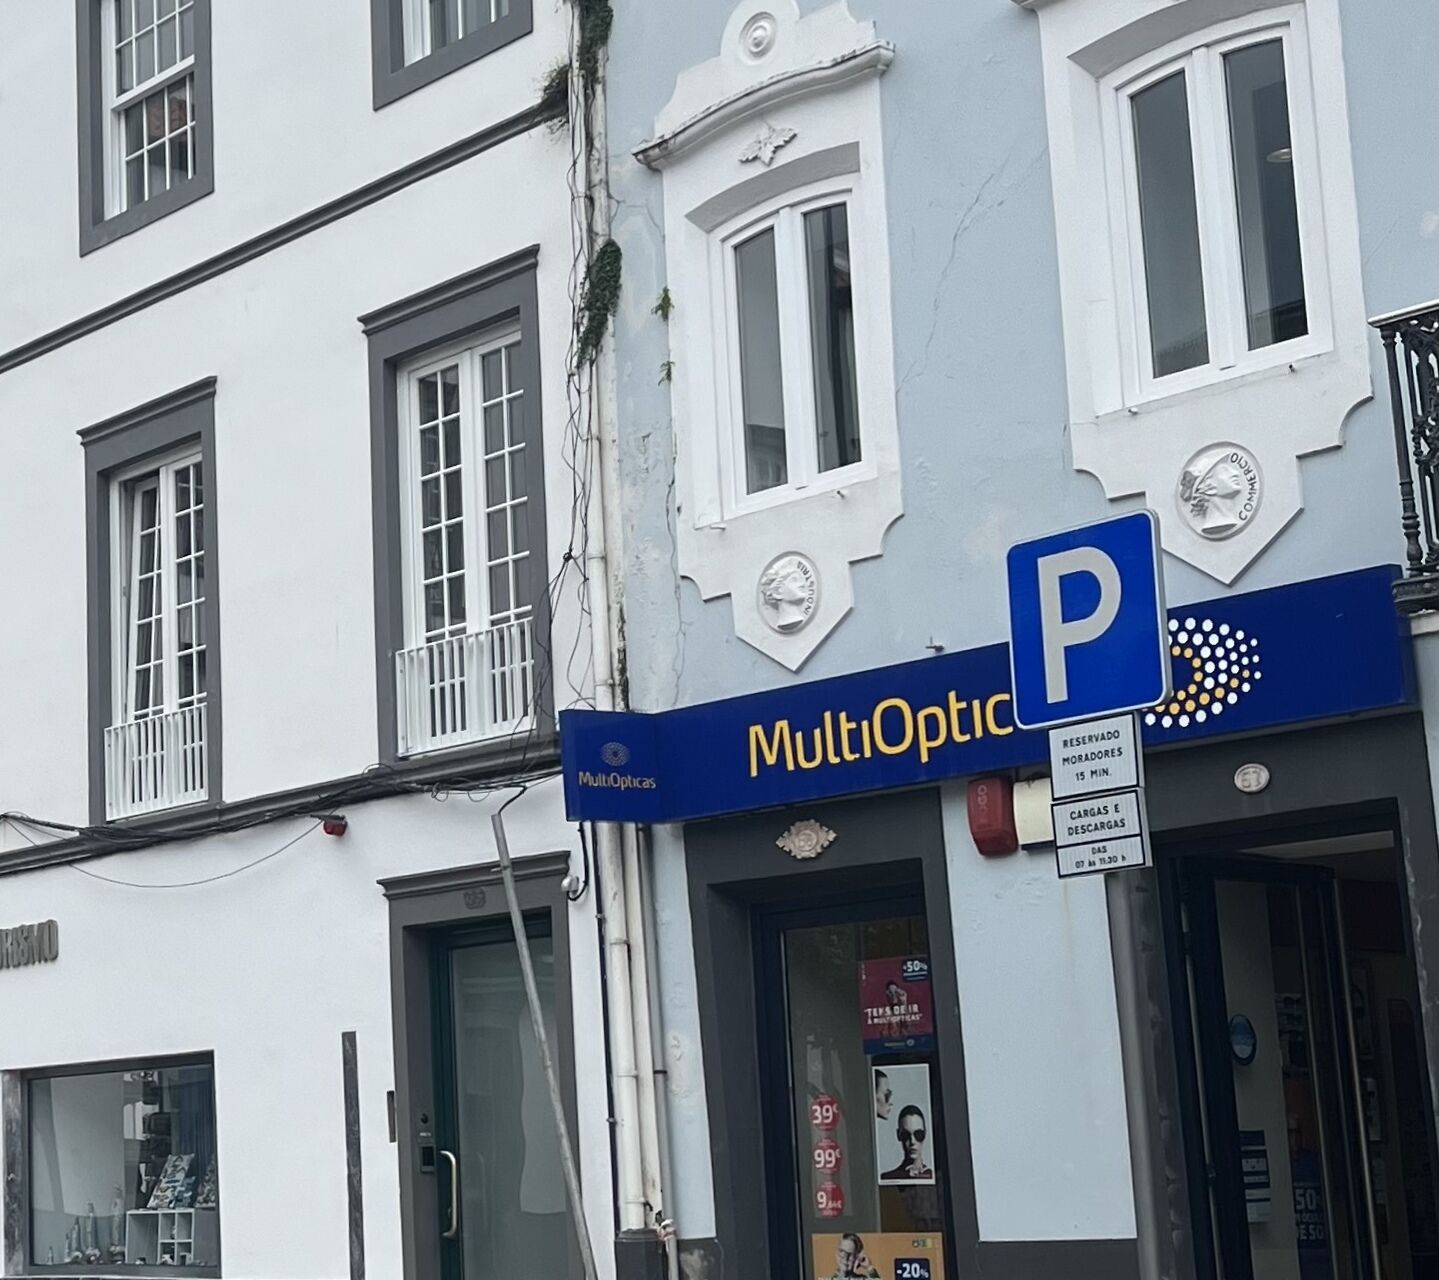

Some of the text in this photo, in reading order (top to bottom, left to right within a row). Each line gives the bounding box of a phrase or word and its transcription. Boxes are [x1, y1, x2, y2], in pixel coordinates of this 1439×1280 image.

[1230, 452, 1257, 521] COMMERCIO
[1037, 546, 1122, 704] P
[747, 689, 1014, 778] MultiOptic
[1062, 729, 1121, 749] RESERVADO
[1062, 747, 1123, 766] MORADORES
[578, 771, 657, 791] MultiOpticas
[1075, 768, 1112, 781] 15 MIN.
[1069, 803, 1121, 821] CARGAS E
[1067, 818, 1126, 836] DESCARGAS
[1091, 846, 1107, 856] DAS
[1075, 860, 1085, 869] 07
[896, 1263, 929, 1279] -20%
